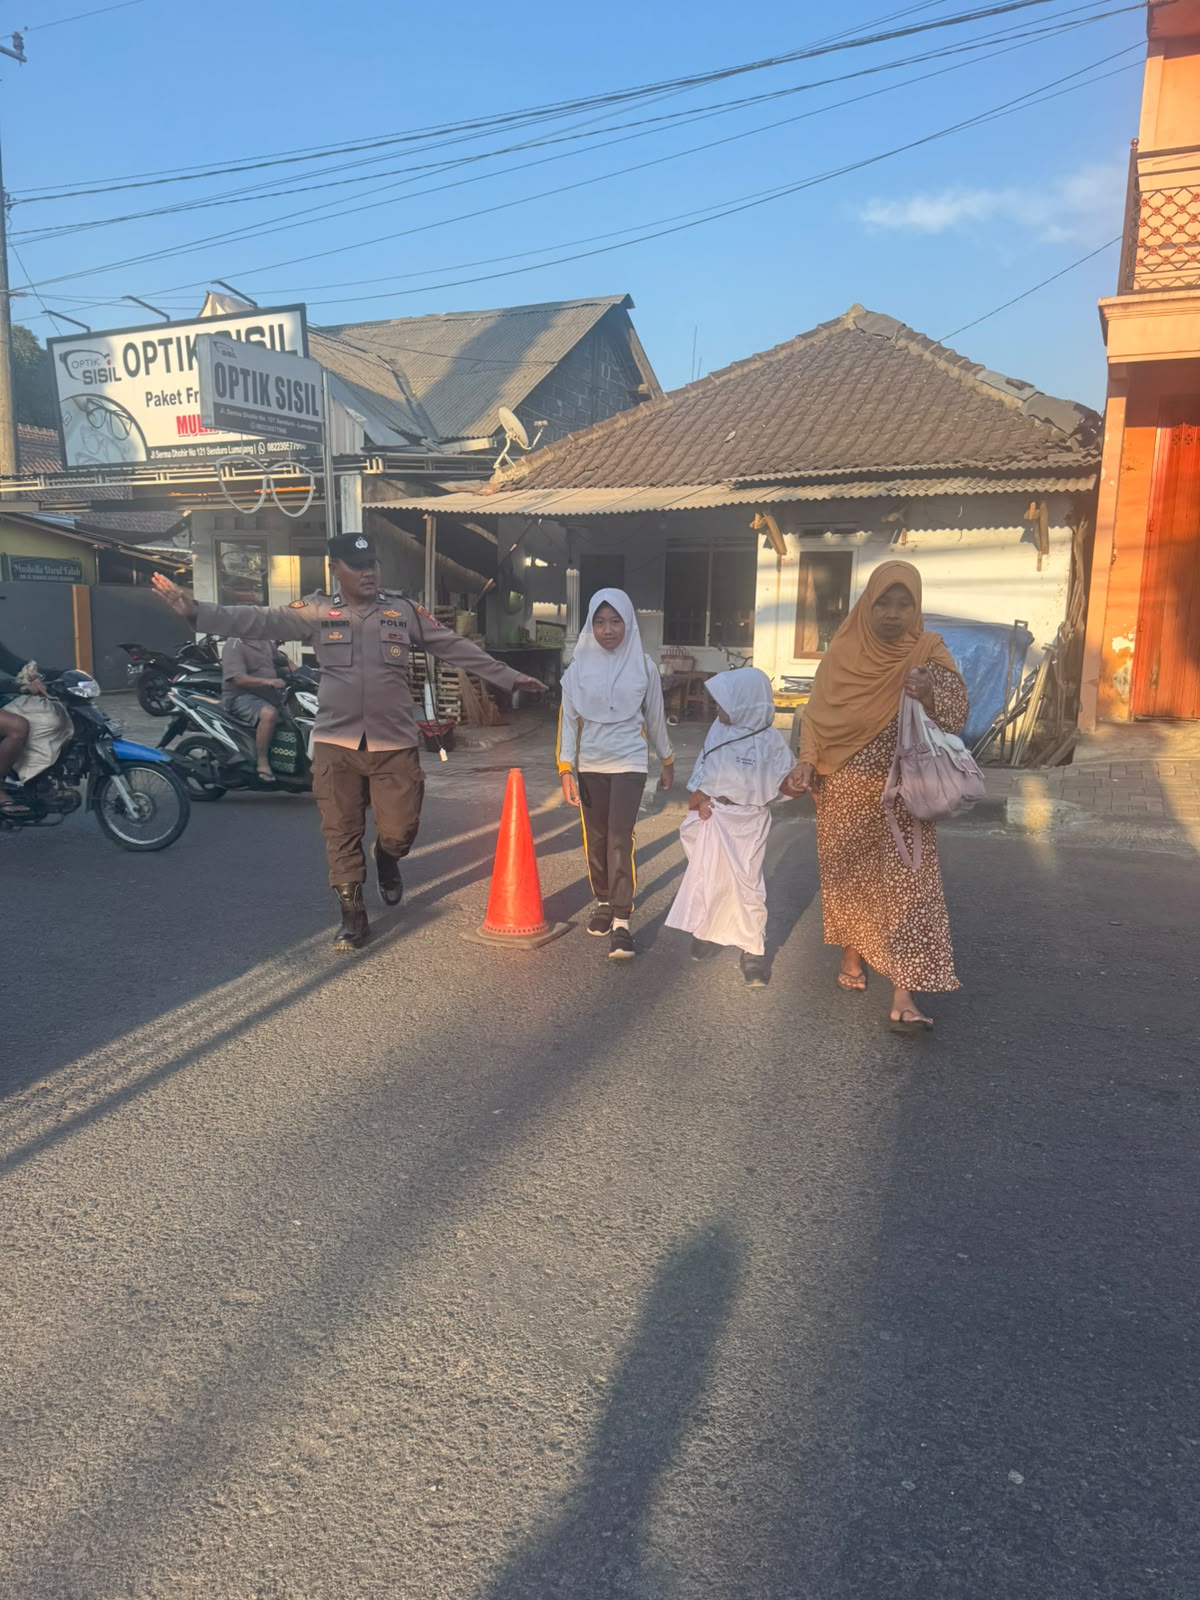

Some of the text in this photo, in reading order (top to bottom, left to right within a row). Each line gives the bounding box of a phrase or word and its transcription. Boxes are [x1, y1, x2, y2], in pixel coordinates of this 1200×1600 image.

[122, 324, 298, 378] OPTIK SIL
[72, 358, 100, 369] OPTIK
[214, 361, 319, 417] OPTIK SISIL
[145, 387, 199, 408] Paket Fr
[188, 447, 196, 457] No
[197, 447, 206, 456] 121
[380, 619, 407, 628] POLRI
